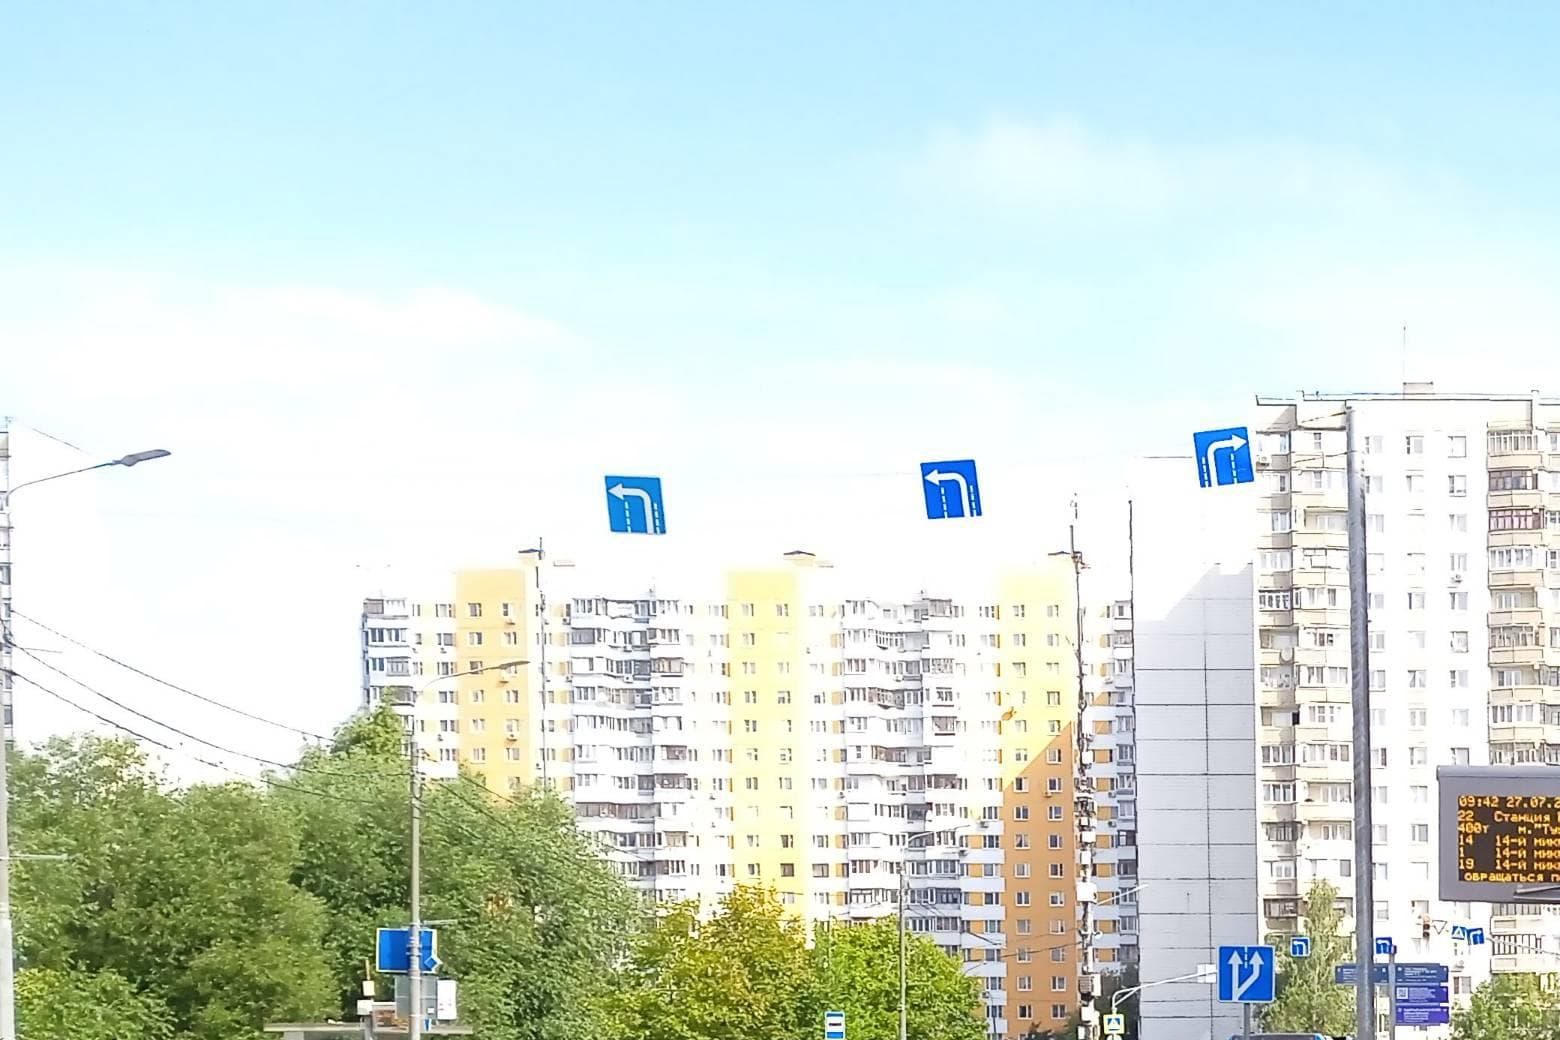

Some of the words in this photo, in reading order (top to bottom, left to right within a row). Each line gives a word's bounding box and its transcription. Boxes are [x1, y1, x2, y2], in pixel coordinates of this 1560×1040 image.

[1459, 796, 1498, 808] 09:42
[1458, 811, 1474, 822] 22
[1494, 810, 1550, 824] Станция
[1458, 823, 1490, 834] 400т
[1460, 836, 1473, 846] 14
[1496, 836, 1526, 847] 14-й
[1460, 848, 1465, 858] 1
[1496, 848, 1526, 859] 14-й
[1459, 859, 1474, 870] 19
[1496, 860, 1526, 871] 14-й
